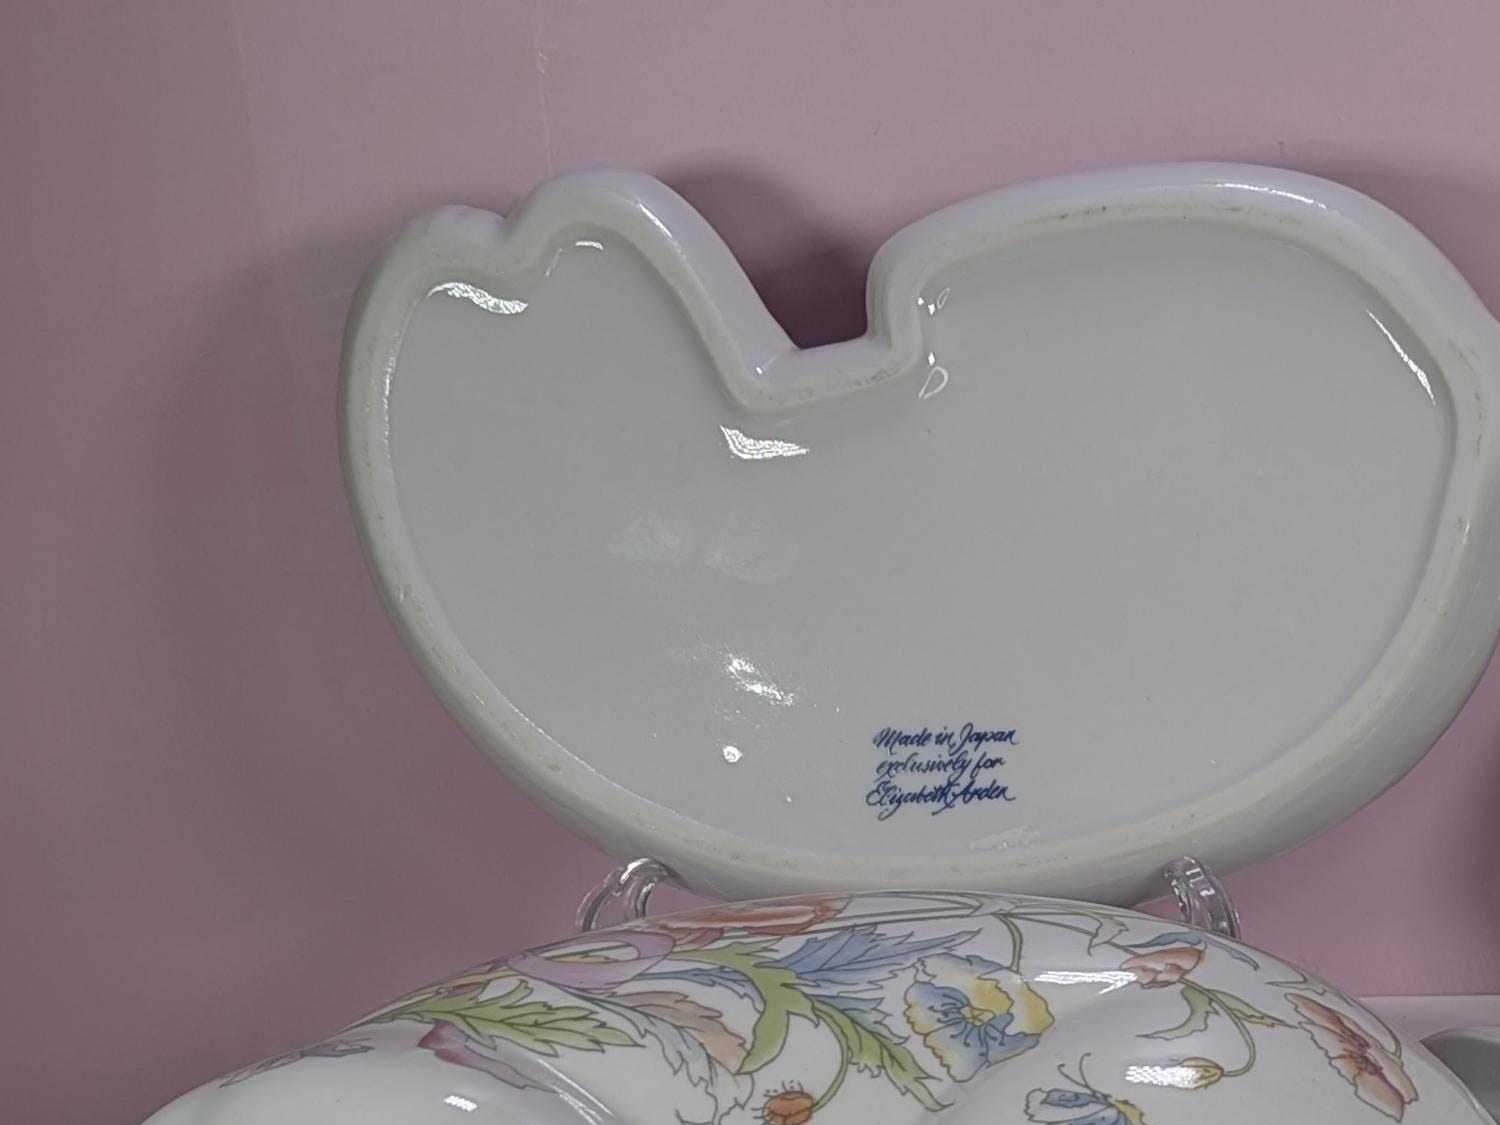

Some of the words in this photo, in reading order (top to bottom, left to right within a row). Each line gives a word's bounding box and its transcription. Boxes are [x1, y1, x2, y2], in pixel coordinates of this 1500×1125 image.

[873, 727, 932, 755] Made
[935, 726, 956, 748] in
[950, 722, 1019, 756] Japan
[874, 750, 971, 782] exclusively
[970, 752, 1006, 778] for
[866, 780, 956, 820] Elizabeth
[950, 779, 1016, 806] Arden
